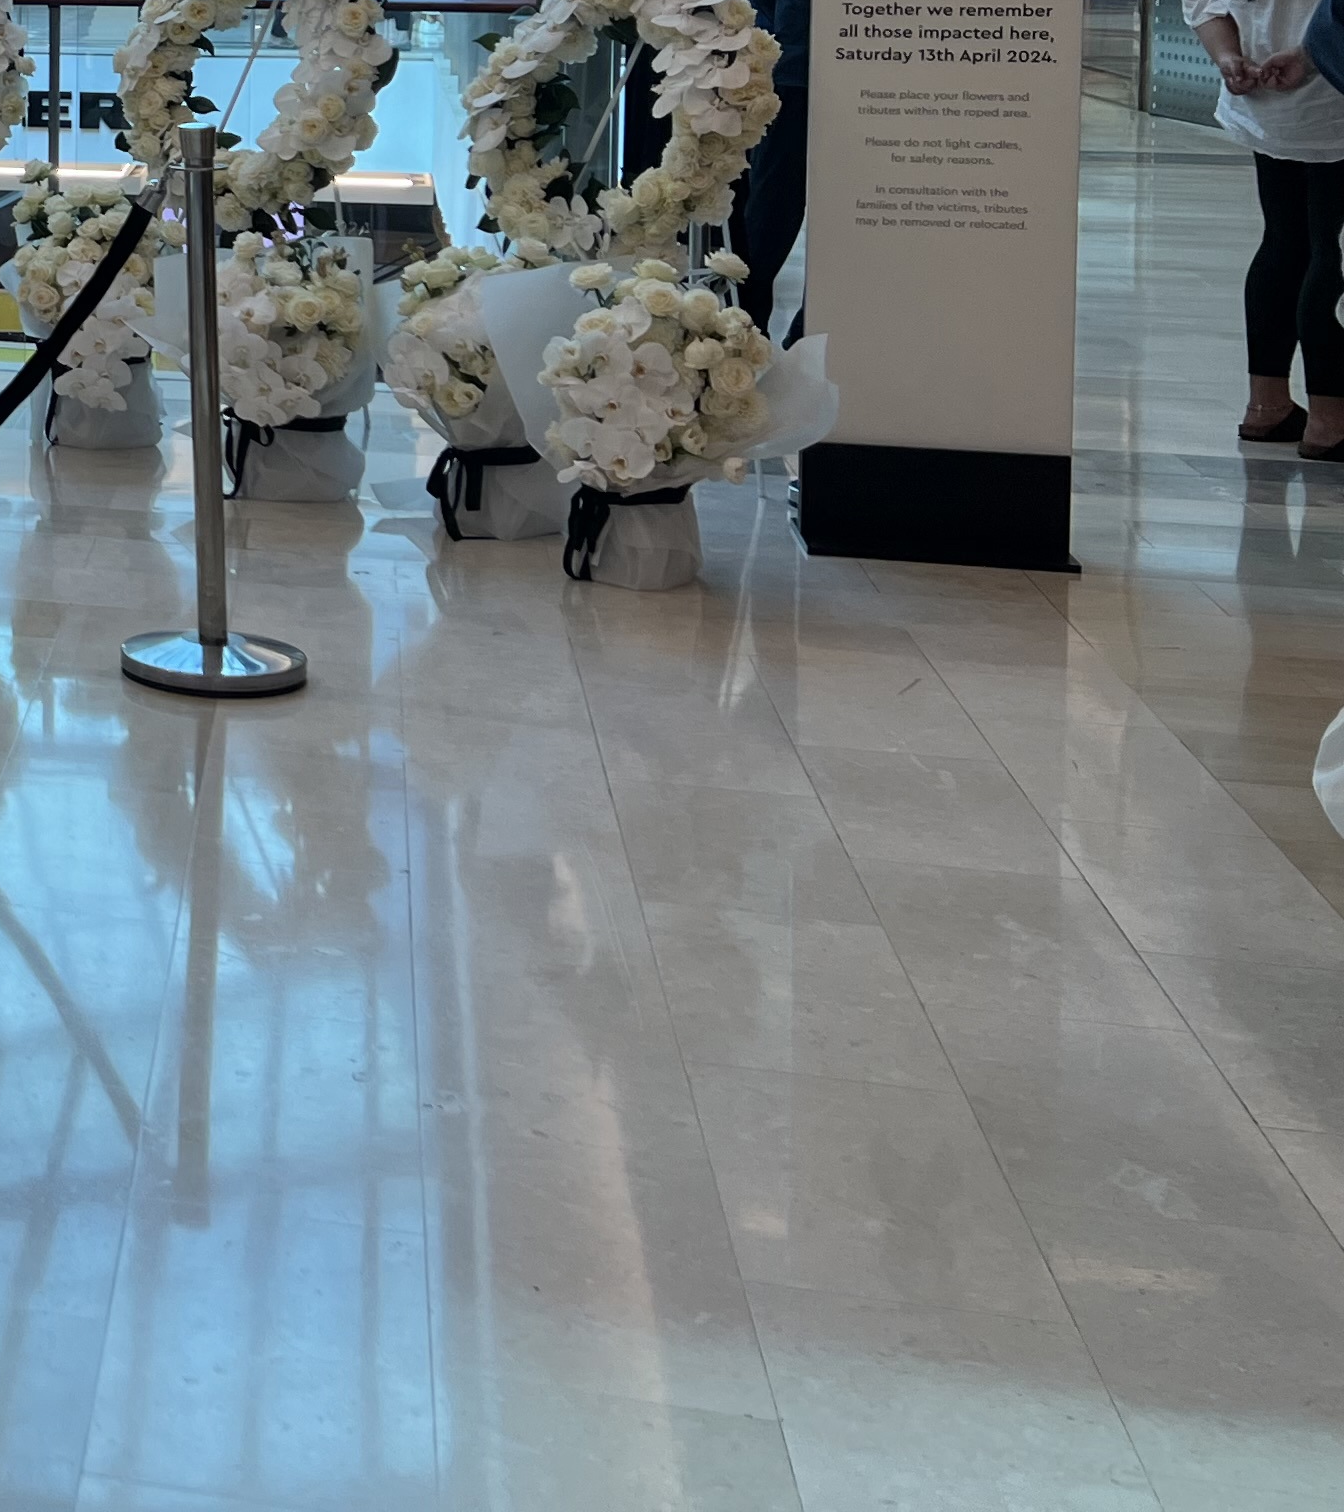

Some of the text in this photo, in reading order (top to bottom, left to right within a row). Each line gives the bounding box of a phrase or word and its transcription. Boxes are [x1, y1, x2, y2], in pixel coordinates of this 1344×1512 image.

[842, 1, 1053, 18] Together we remember
[839, 24, 1055, 43] all those impacted here,
[835, 47, 1057, 64] Saturday 13th April 2024.
[860, 90, 1030, 102] Please place your flowers and
[858, 106, 901, 116] tributes
[904, 106, 938, 116] within
[942, 107, 960, 116] the
[964, 108, 999, 118] roped
[865, 137, 900, 147] Please
[904, 138, 920, 147] do
[923, 140, 942, 148] not
[946, 138, 970, 150] light
[888, 186, 958, 196] consultation
[962, 188, 986, 197] with
[990, 188, 1009, 198] the
[901, 200, 914, 211] of
[916, 201, 934, 211] the
[984, 204, 1028, 215] tributes
[855, 217, 879, 227] may
[882, 217, 897, 226] be
[900, 218, 951, 228] removed
[954, 221, 966, 229] or
